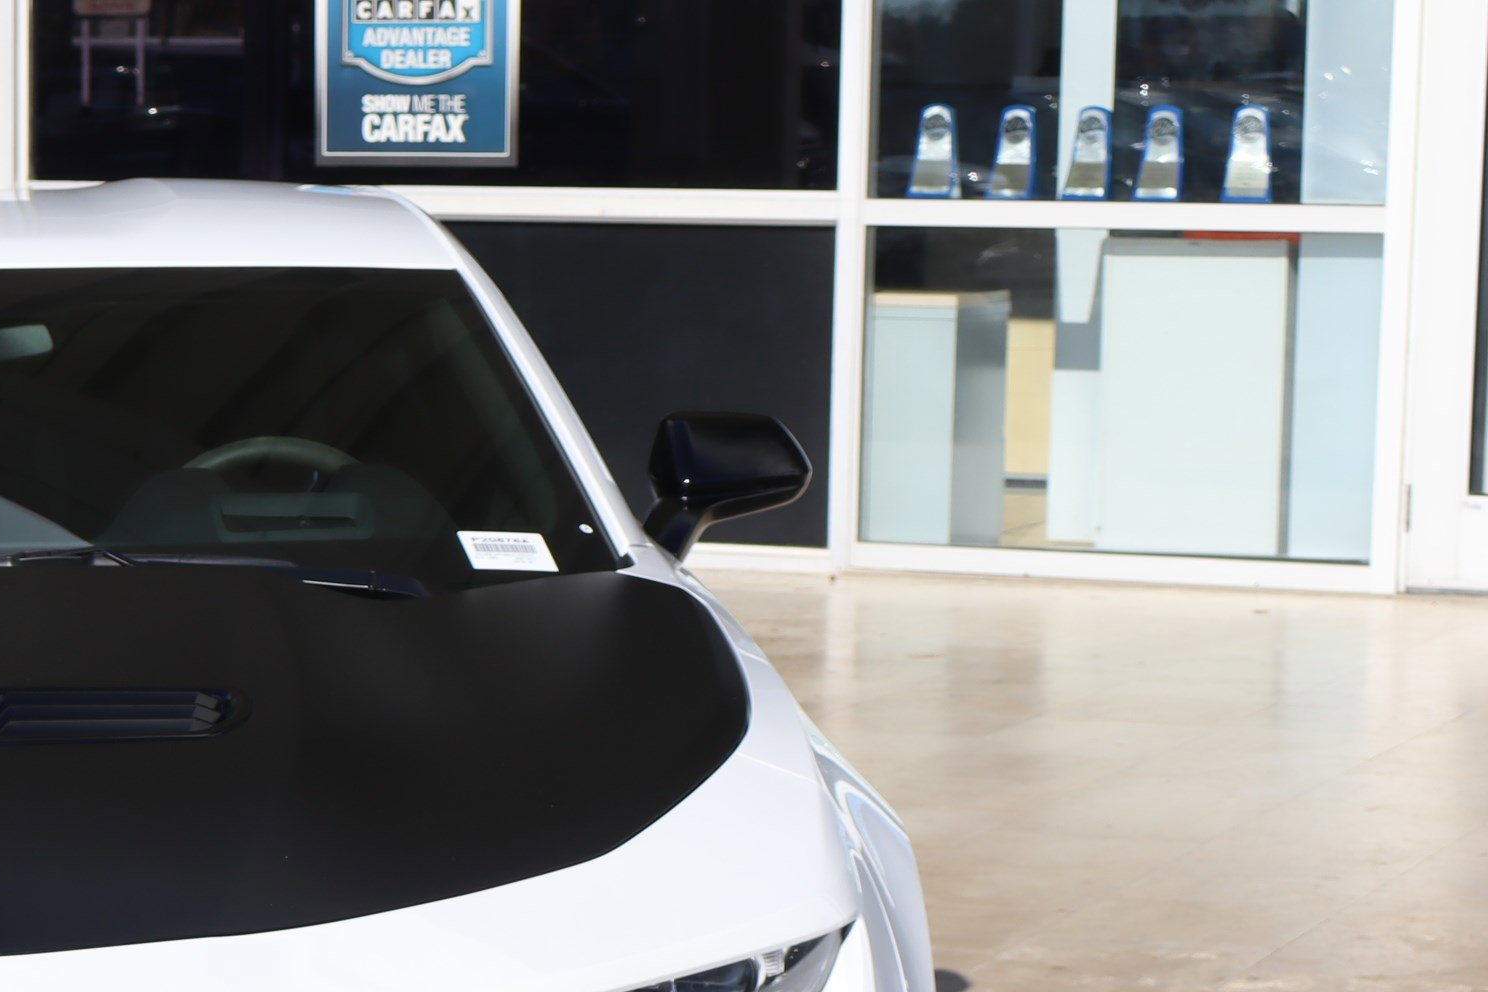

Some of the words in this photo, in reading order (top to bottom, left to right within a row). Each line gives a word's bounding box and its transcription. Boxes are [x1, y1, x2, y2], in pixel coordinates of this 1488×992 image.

[356, 0, 479, 19] CARFAX
[362, 27, 471, 47] ADVANTAGE
[380, 49, 451, 69] DEALER
[361, 94, 410, 113] SHOW
[412, 94, 436, 113] ME
[437, 94, 466, 113] THE
[361, 113, 467, 143] CARFAX
